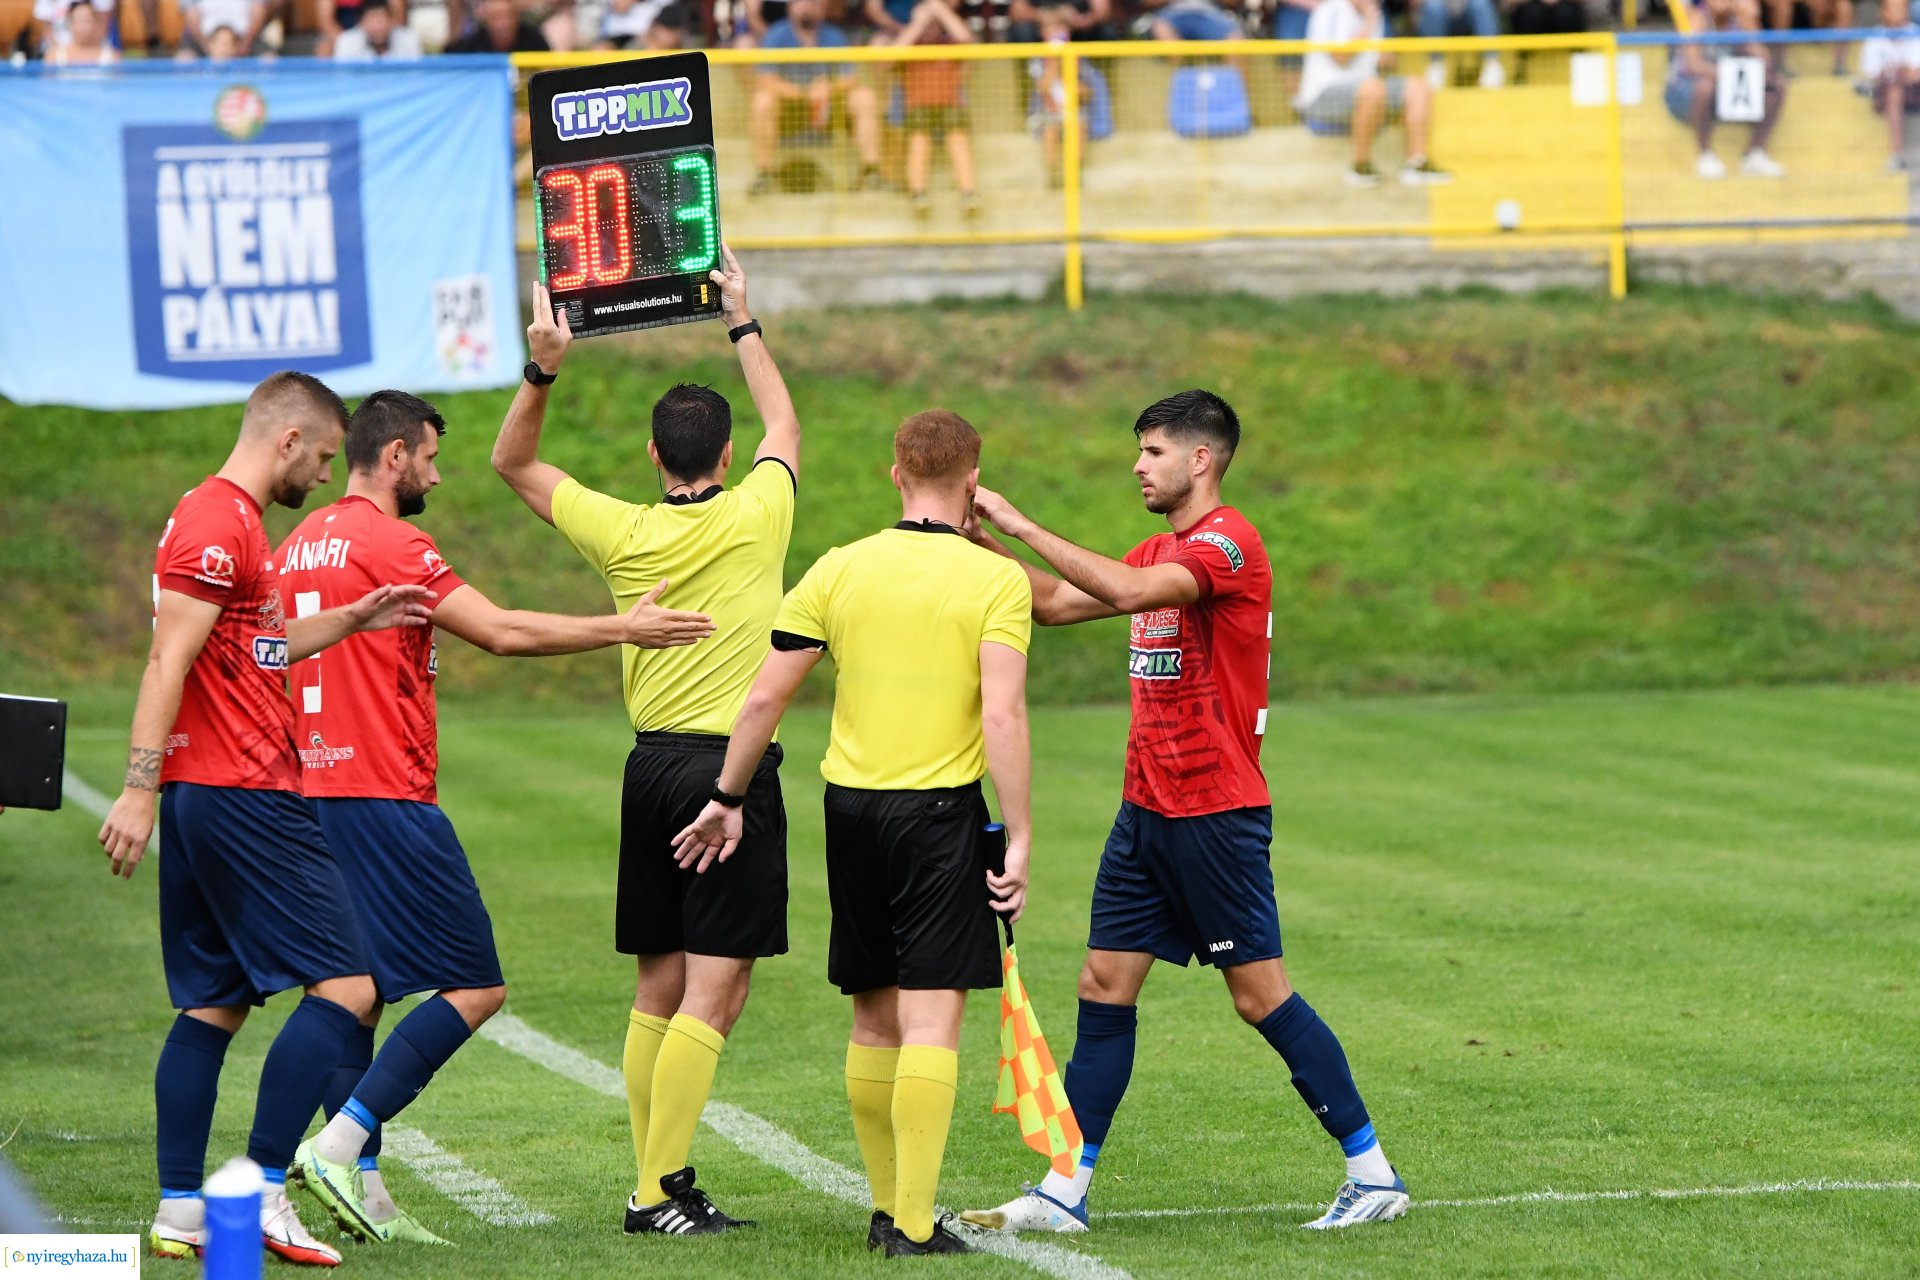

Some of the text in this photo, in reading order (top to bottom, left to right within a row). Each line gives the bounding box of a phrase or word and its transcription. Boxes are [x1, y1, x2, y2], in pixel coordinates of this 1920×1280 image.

[1732, 66, 1752, 108] A
[157, 162, 182, 198] A
[157, 193, 337, 289] NEM
[545, 156, 715, 288] 30 3
[163, 285, 340, 354] PÁLYA!
[594, 294, 683, 316] www.visualsolutions.hu
